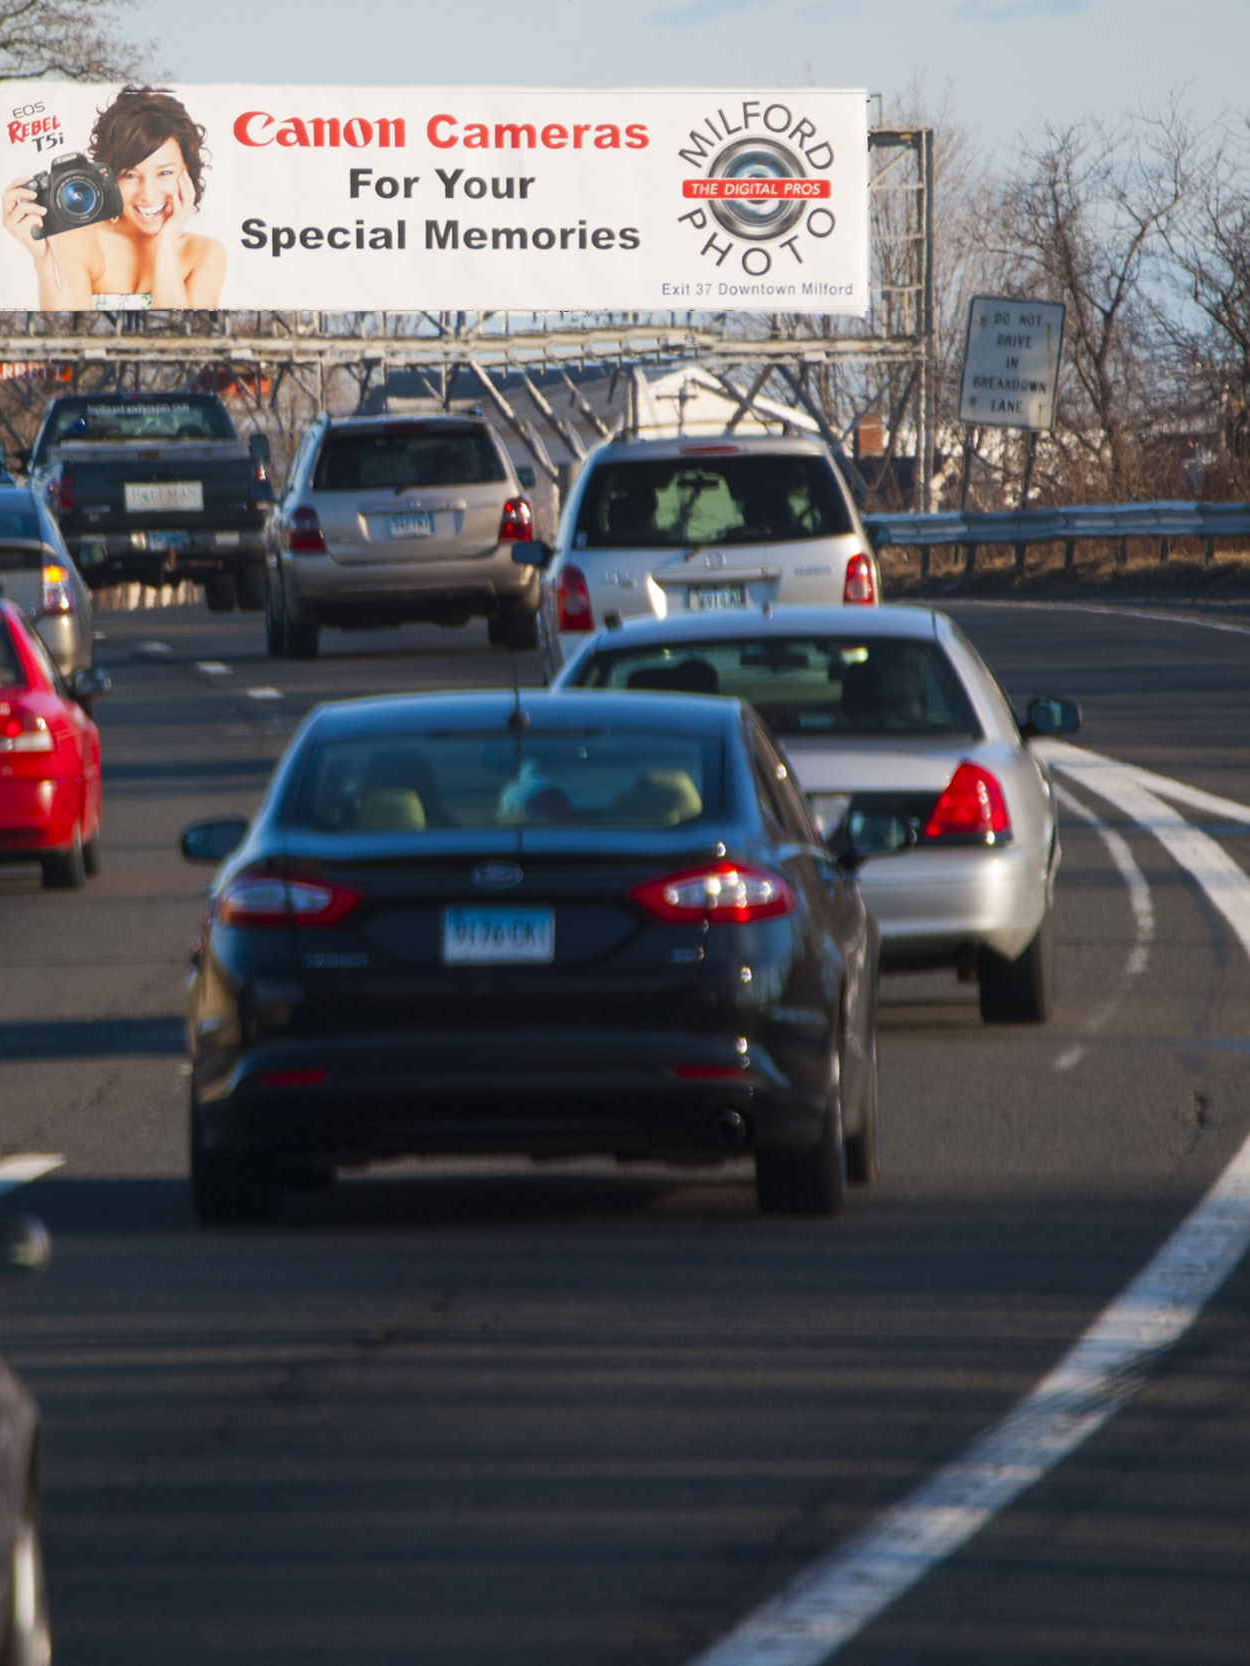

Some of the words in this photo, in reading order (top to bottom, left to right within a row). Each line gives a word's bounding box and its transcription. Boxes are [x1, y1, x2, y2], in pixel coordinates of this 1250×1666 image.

[12, 101, 46, 119] EOS
[7, 115, 61, 144] REBEL
[233, 111, 406, 148] Canon
[426, 113, 650, 149] Cameras
[678, 100, 835, 170] MILFORD
[31, 132, 64, 153] T5i
[349, 168, 421, 199] For
[434, 168, 536, 200] Your
[691, 183, 718, 195] THE
[724, 183, 778, 195] DIGITAL
[784, 183, 821, 195] PROS
[240, 218, 406, 257] Special
[425, 219, 641, 250] Memories
[677, 207, 836, 277] PHOTO
[662, 283, 690, 296] Exit
[696, 283, 712, 296] 37
[718, 283, 796, 296] Downtown
[802, 283, 853, 296] Milford
[994, 312, 1010, 326] DO
[1020, 313, 1043, 327] NOT
[996, 333, 1033, 349] DRIVE
[1006, 355, 1020, 369] IN
[991, 398, 1023, 413] LANE
